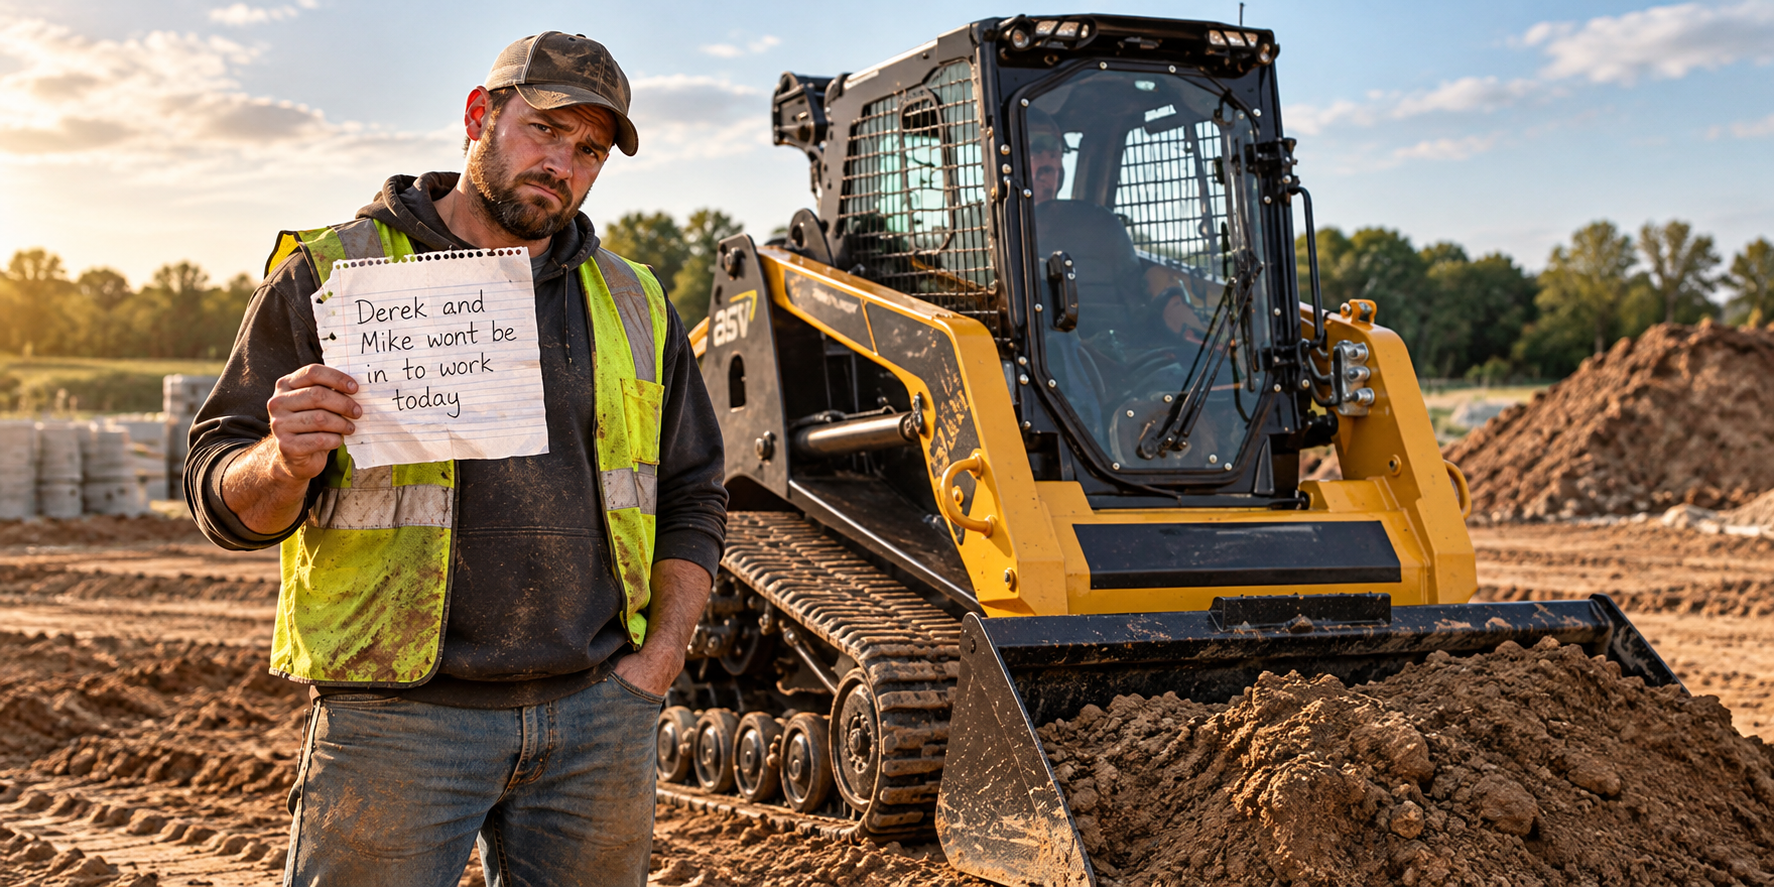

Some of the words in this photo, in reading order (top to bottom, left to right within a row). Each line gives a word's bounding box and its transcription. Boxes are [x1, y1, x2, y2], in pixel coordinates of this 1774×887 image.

[355, 296, 428, 325] Derek
[442, 289, 485, 316] and
[361, 328, 414, 354] Mike
[427, 321, 479, 349] wont
[491, 319, 517, 342] be
[366, 364, 388, 384] in
[402, 357, 426, 380] to
[439, 352, 494, 377] work
[391, 386, 461, 419] today
